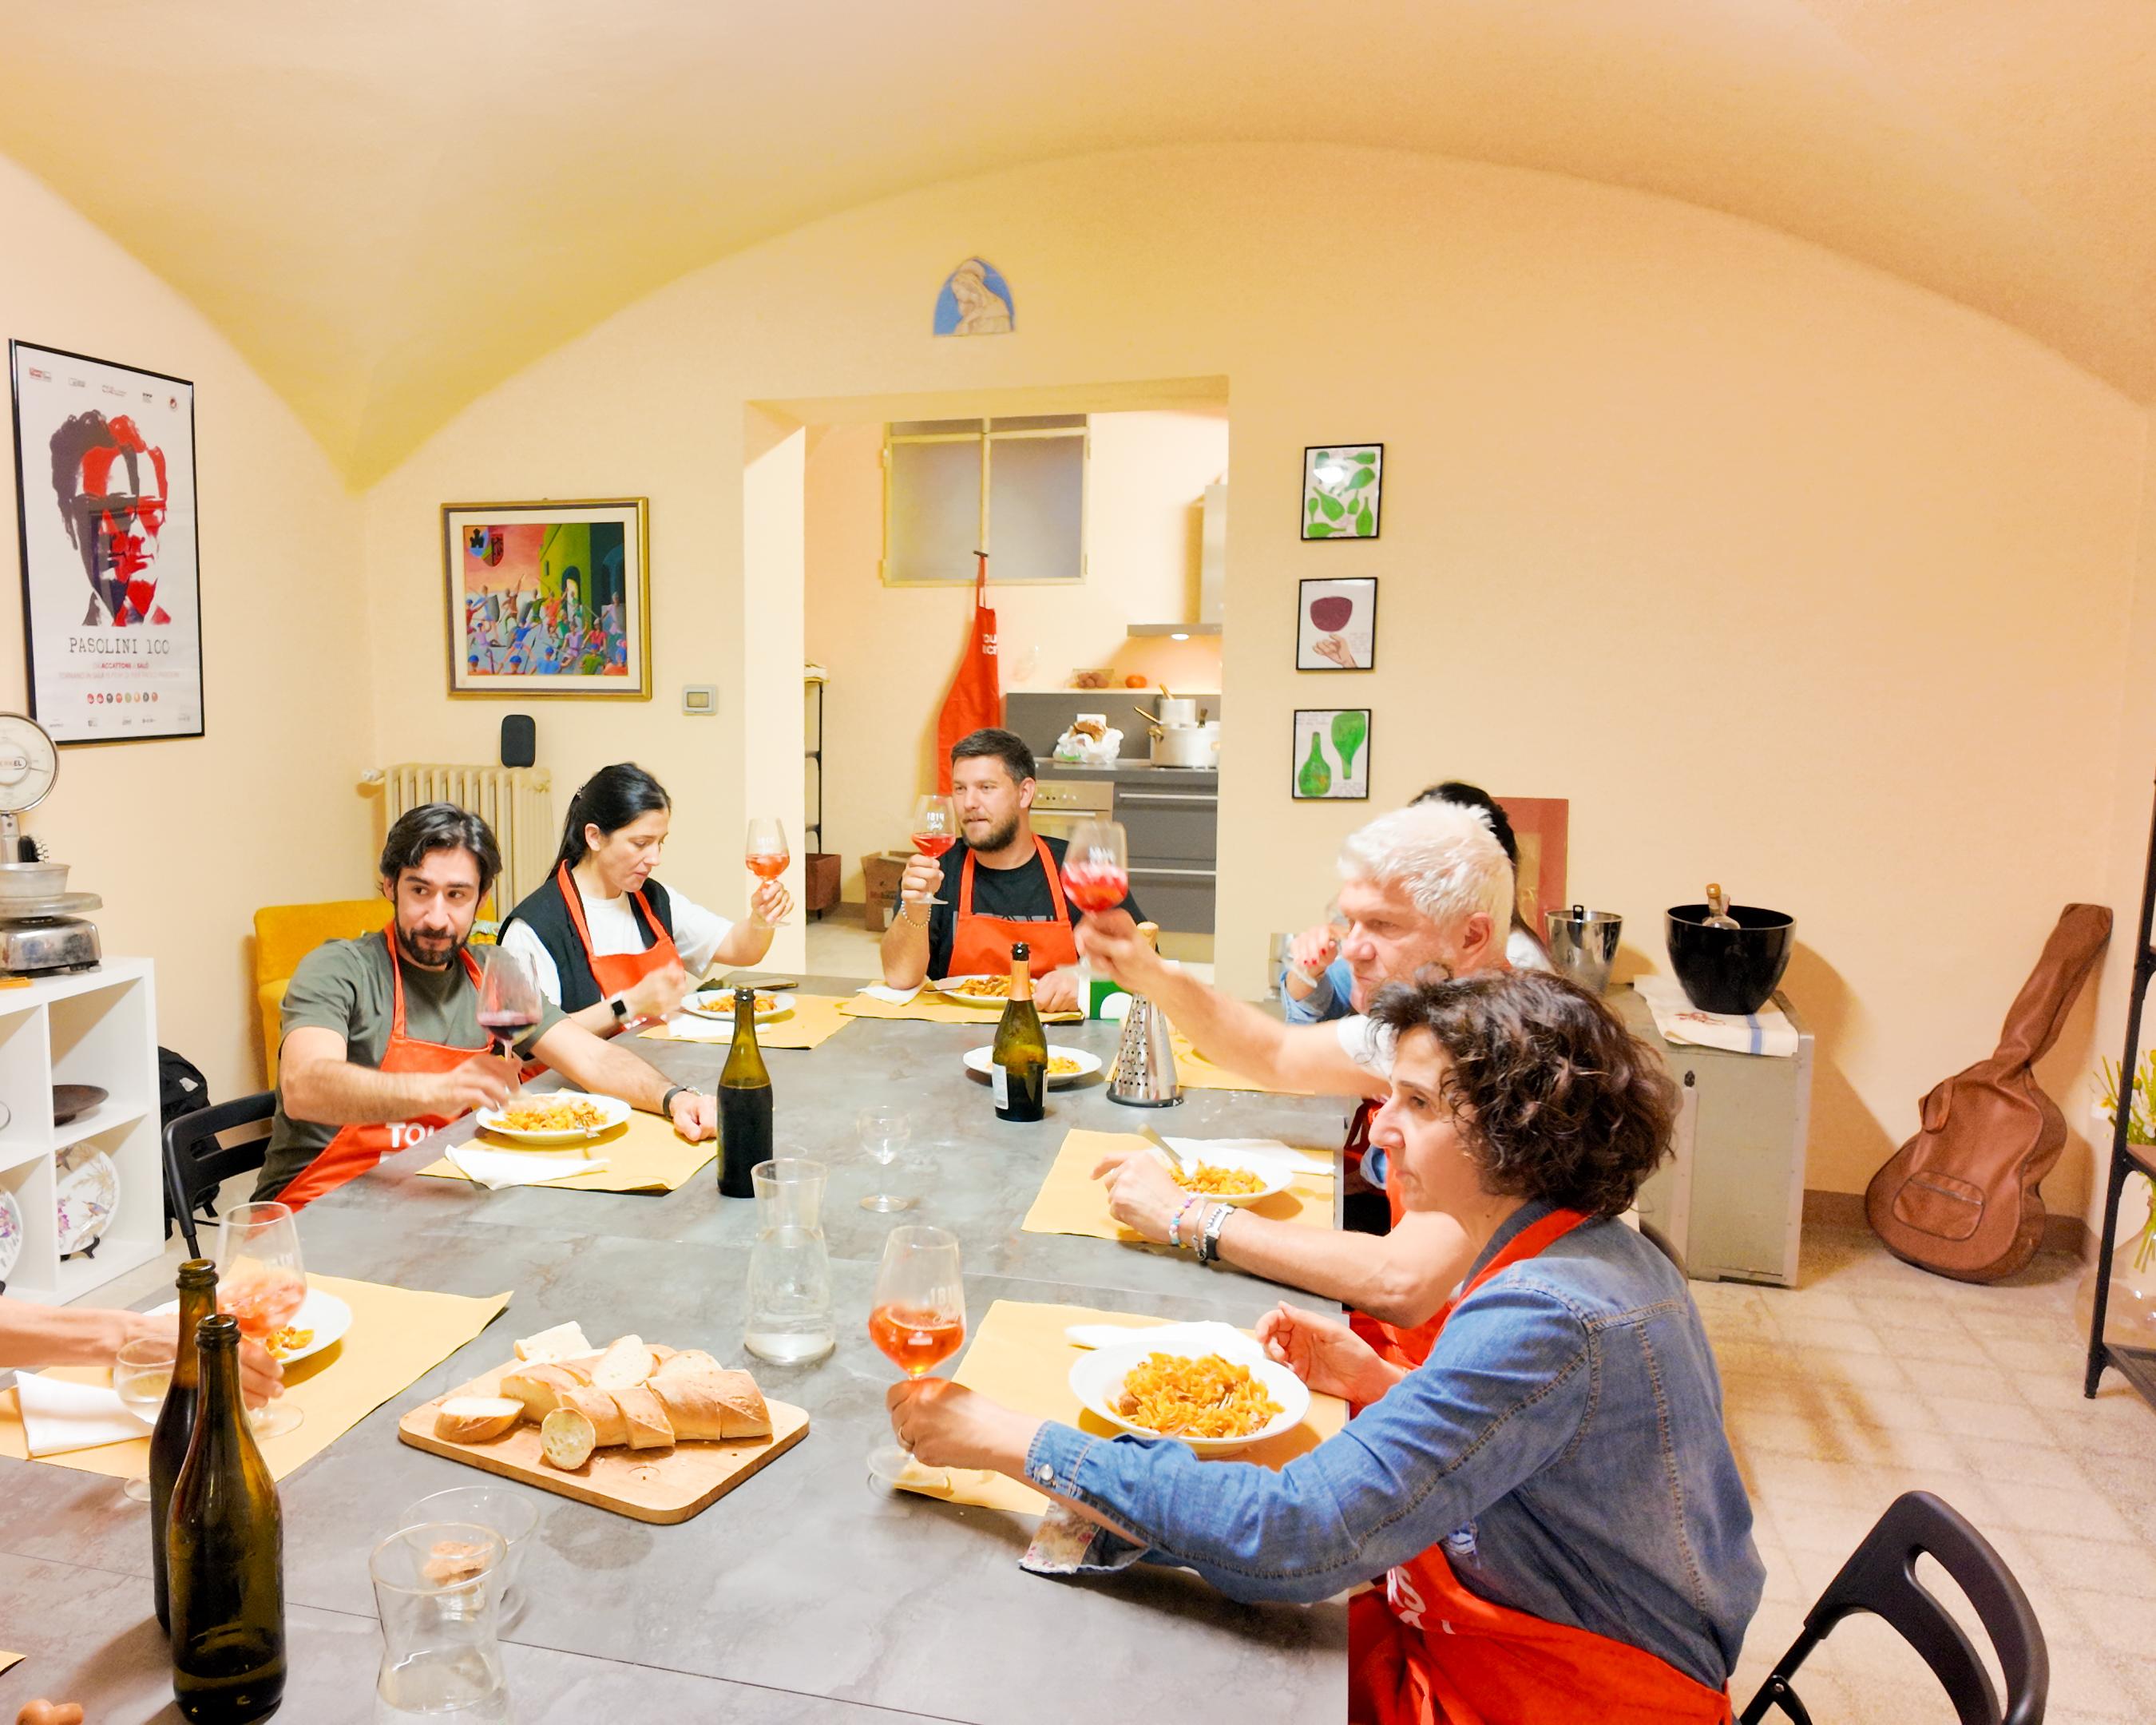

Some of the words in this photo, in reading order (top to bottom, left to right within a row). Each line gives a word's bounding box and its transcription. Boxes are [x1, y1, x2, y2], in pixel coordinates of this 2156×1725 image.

[69, 637, 138, 654] PASOLINI
[147, 639, 170, 655] 100
[385, 1122, 435, 1148] TO
